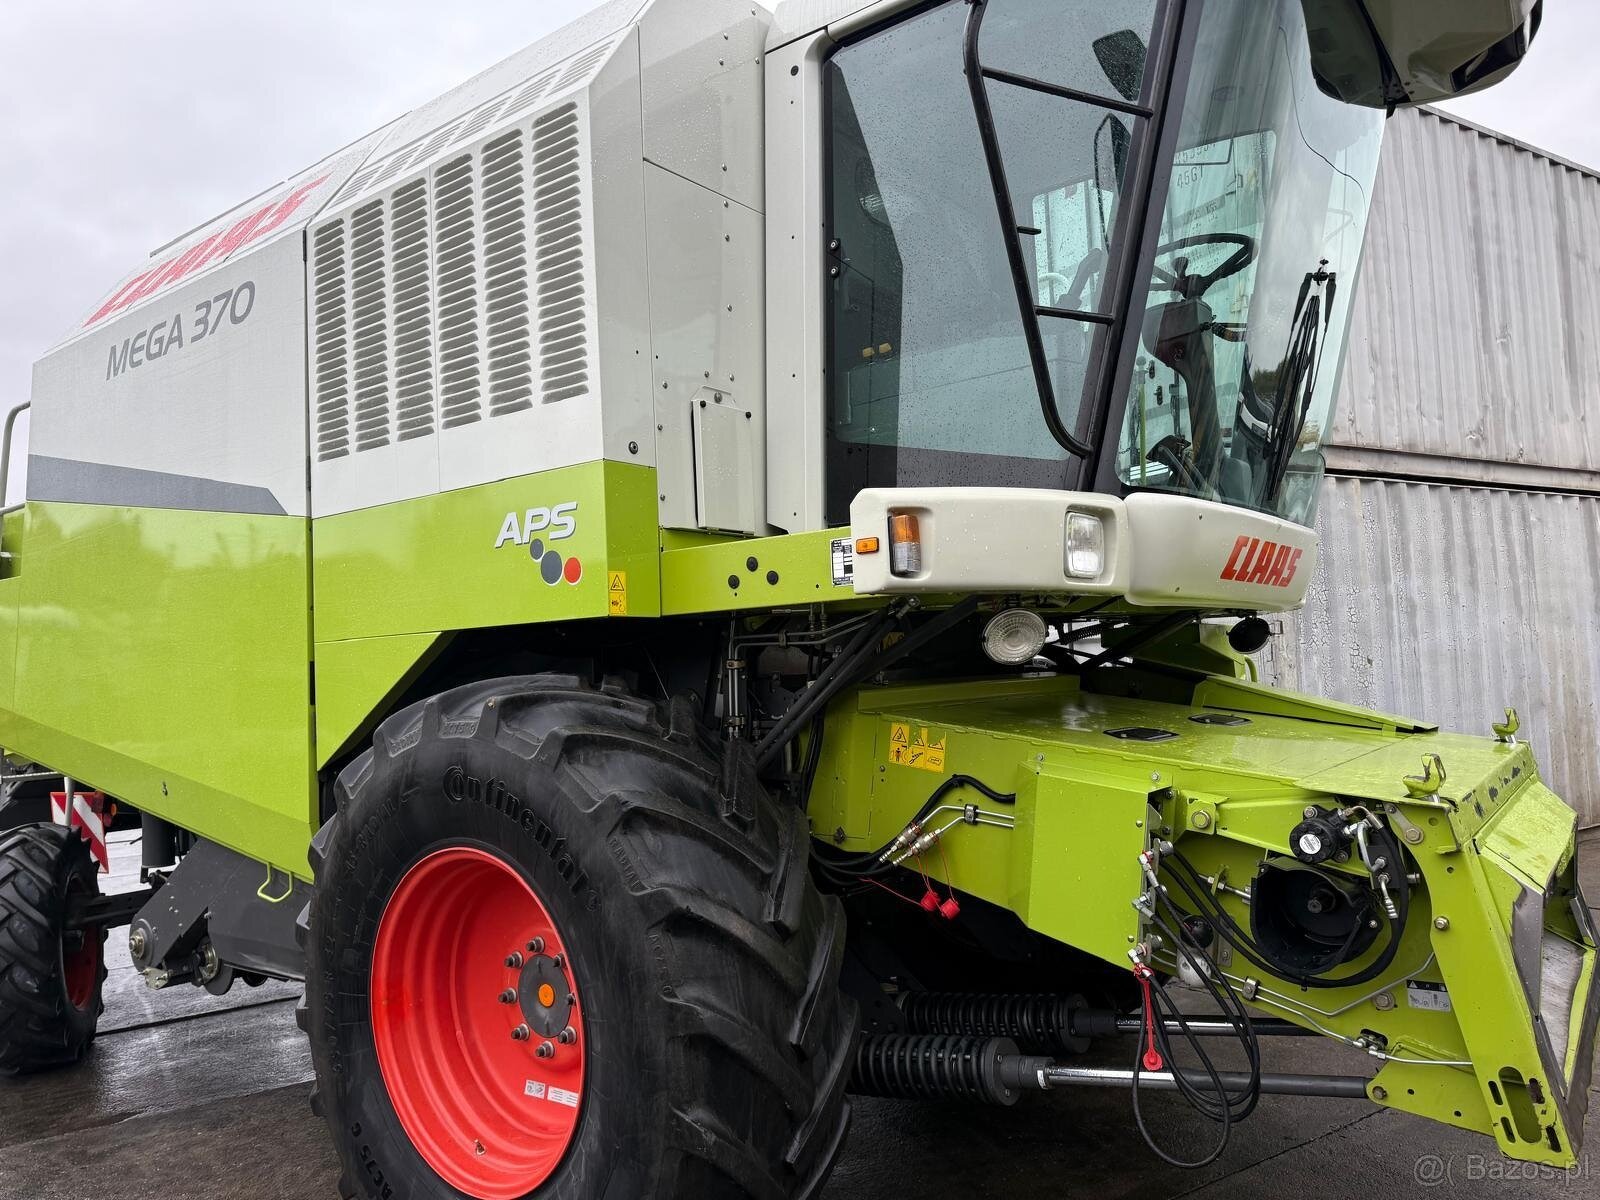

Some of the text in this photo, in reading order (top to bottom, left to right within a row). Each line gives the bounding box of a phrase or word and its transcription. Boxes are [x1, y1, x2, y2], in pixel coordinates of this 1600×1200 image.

[106, 280, 256, 381] MEGA 370
[494, 501, 578, 549] APS
[1219, 535, 1303, 587] CLAAS
[443, 765, 590, 897] Continental
